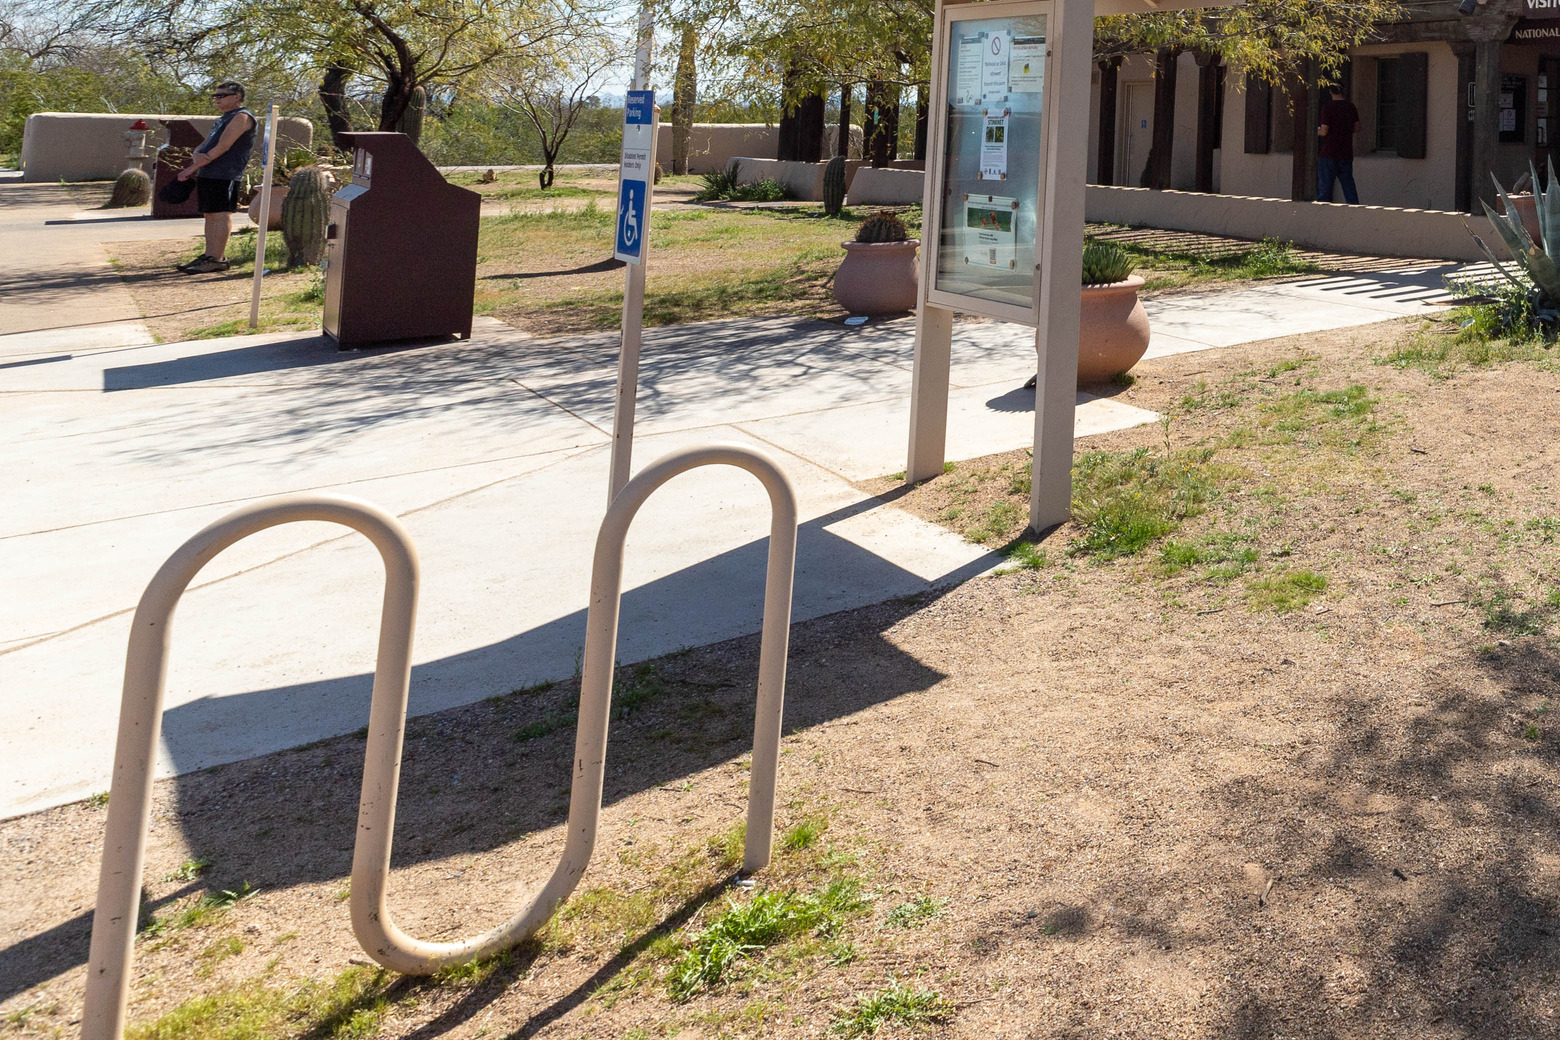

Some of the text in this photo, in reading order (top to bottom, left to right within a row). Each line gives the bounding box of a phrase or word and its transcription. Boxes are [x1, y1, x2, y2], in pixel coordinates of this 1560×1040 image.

[1515, 27, 1560, 39] NATIONAL
[628, 94, 645, 104] Reserved
[627, 108, 642, 120] Parking
